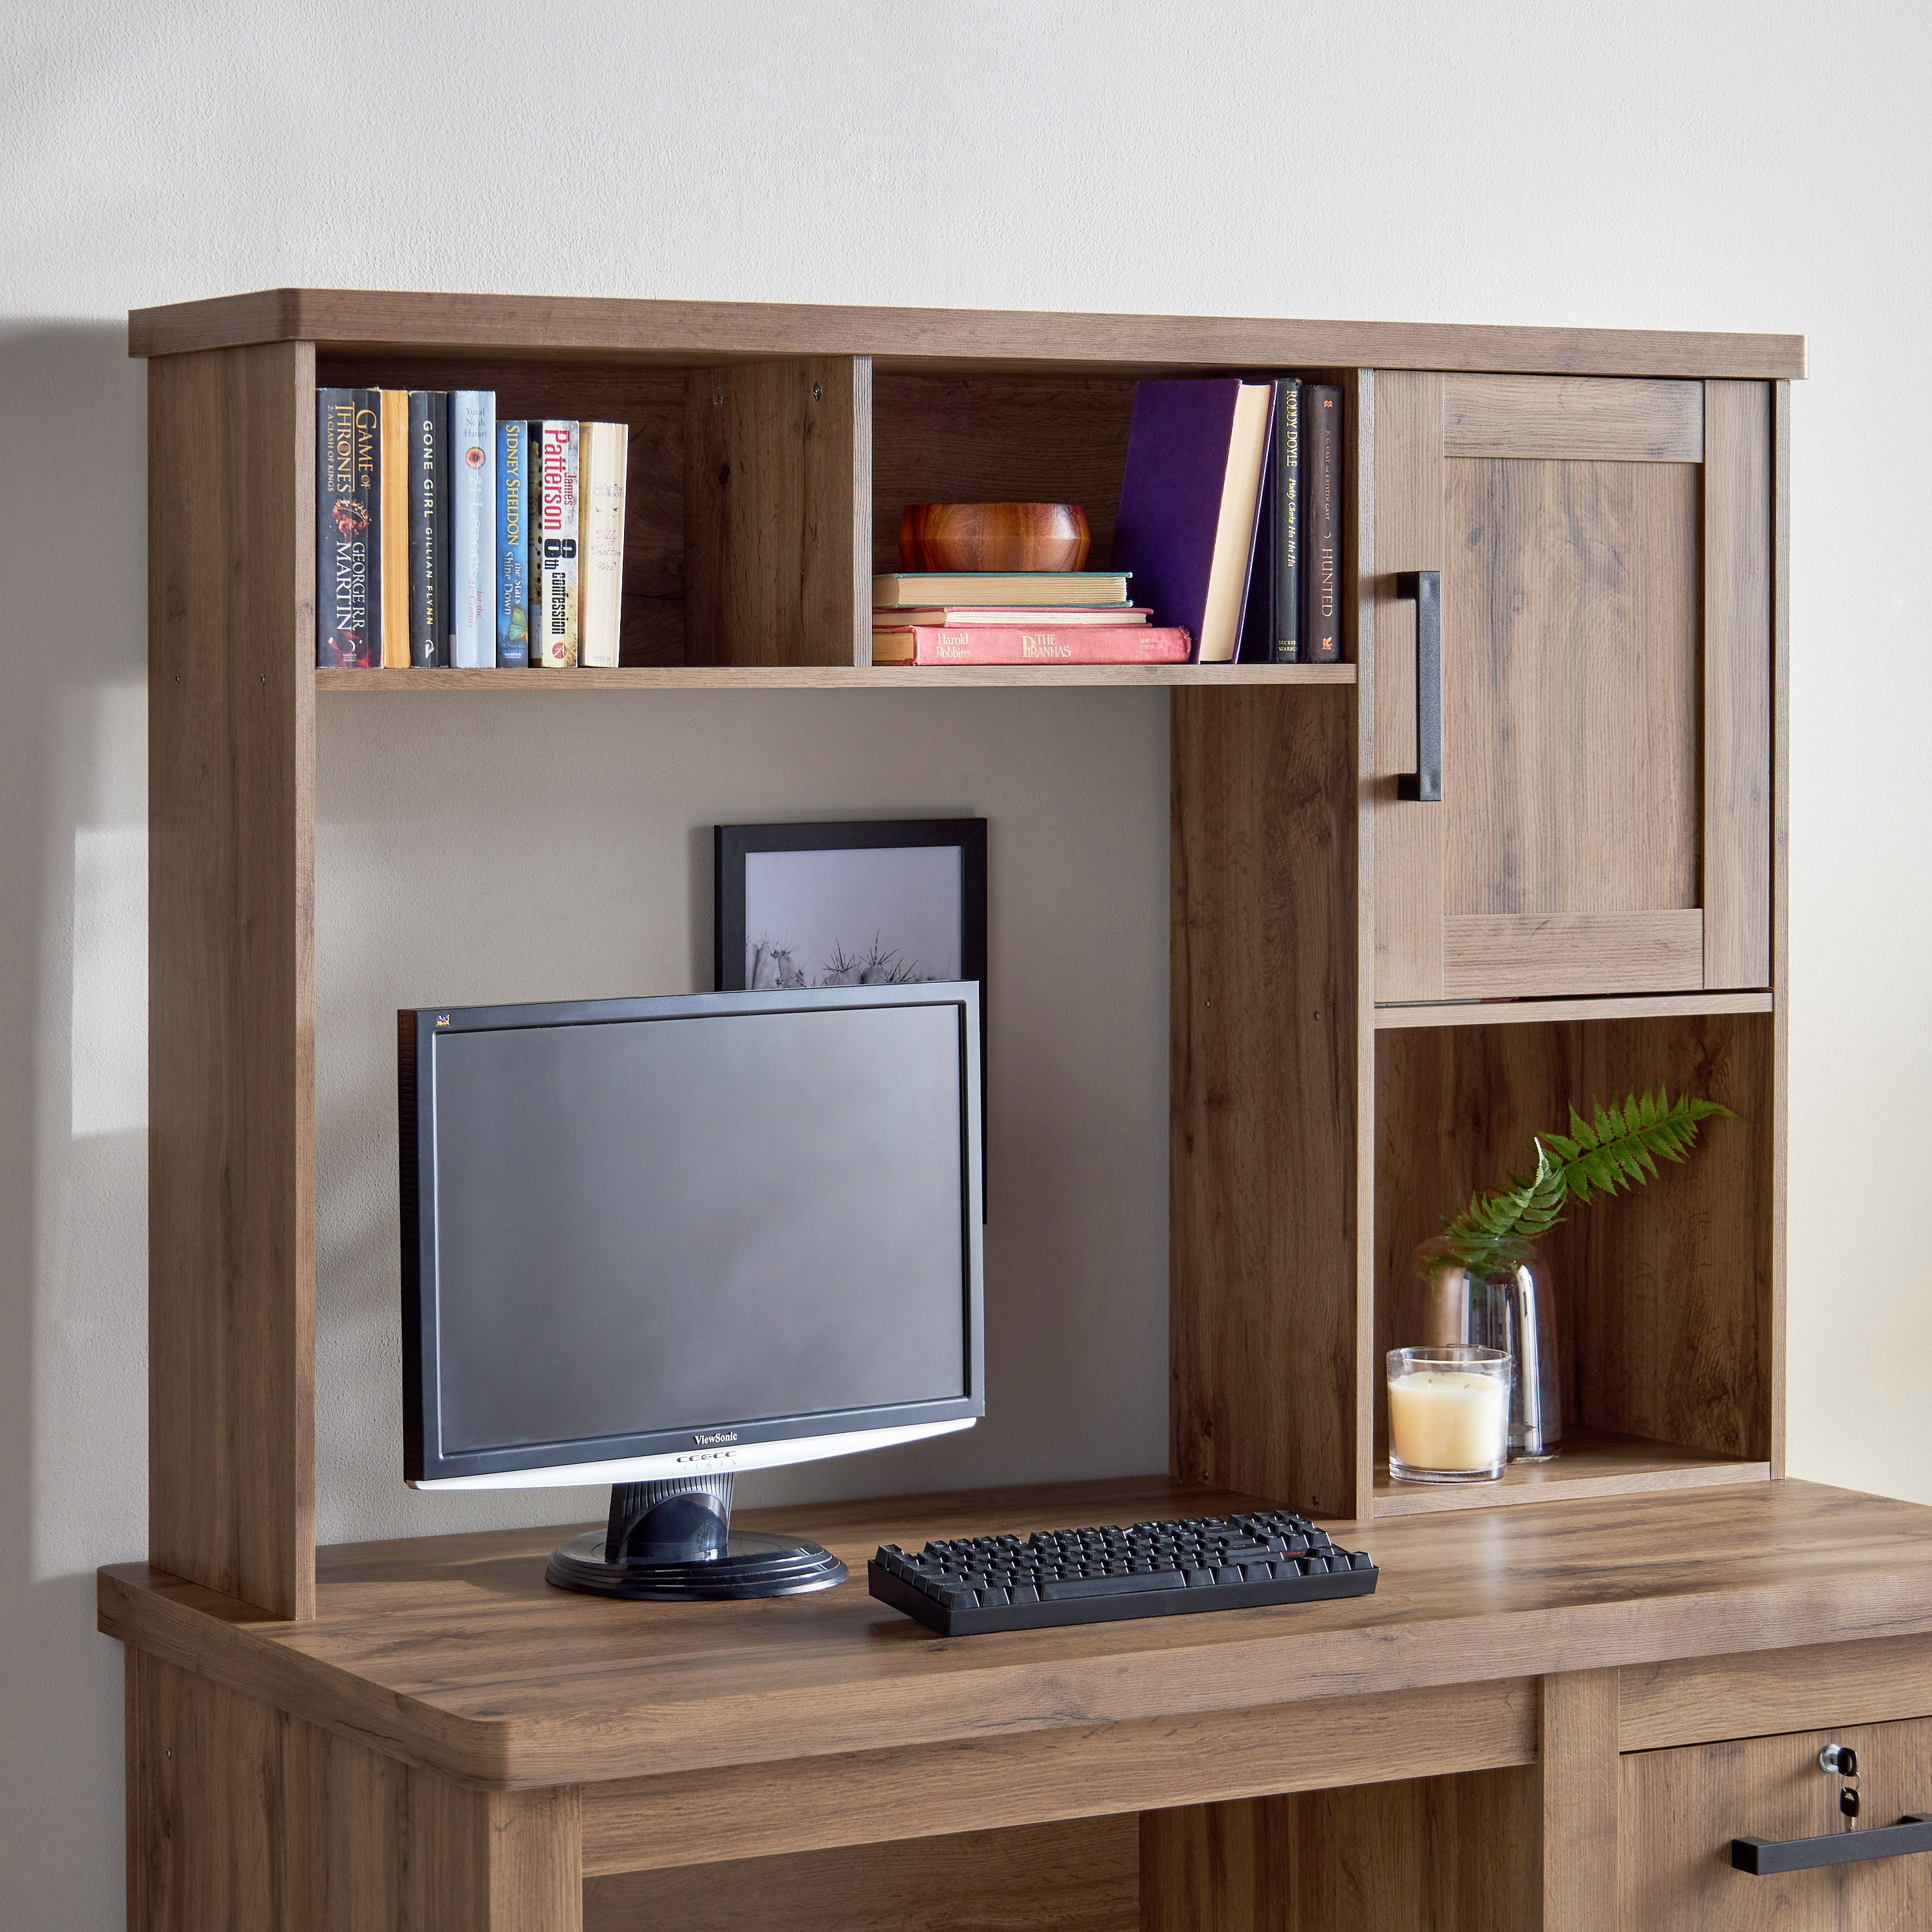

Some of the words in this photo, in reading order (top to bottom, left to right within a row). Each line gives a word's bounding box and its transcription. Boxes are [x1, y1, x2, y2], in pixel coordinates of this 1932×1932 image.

[466, 407, 485, 415] Yuval
[466, 418, 485, 426] Noah
[1287, 390, 1298, 429] RODDY
[335, 402, 355, 493] THRONES
[356, 410, 377, 471] GAME
[422, 421, 433, 470] GONE
[464, 429, 487, 437] Harari
[327, 451, 334, 462] OF
[506, 425, 519, 478] SIDNEY
[1287, 431, 1298, 467] DOYLE
[361, 475, 370, 489] OF
[469, 475, 482, 494] 21
[544, 430, 570, 530] Patterson
[564, 473, 577, 506] James
[1287, 478, 1296, 500] Paddy
[424, 479, 433, 518] GIRL
[507, 479, 520, 545] SHELDON
[469, 502, 482, 573] Lessons
[1288, 526, 1295, 538] Ha
[1288, 540, 1295, 553] Ha
[504, 551, 513, 580] Shine
[544, 539, 576, 570] 8th
[1288, 554, 1295, 567] Ha
[336, 541, 352, 631] MARTIN
[352, 542, 365, 603] GEORGE
[1321, 549, 1333, 617] HUNTED
[467, 595, 476, 629] Century
[504, 583, 513, 614] Down
[552, 573, 569, 634] confession
[936, 646, 971, 658] Robbins
[937, 632, 969, 645] Harold
[1021, 636, 1072, 658] PIRANHAS
[1034, 634, 1057, 645] THE
[694, 1432, 737, 1445] ViewSonic
